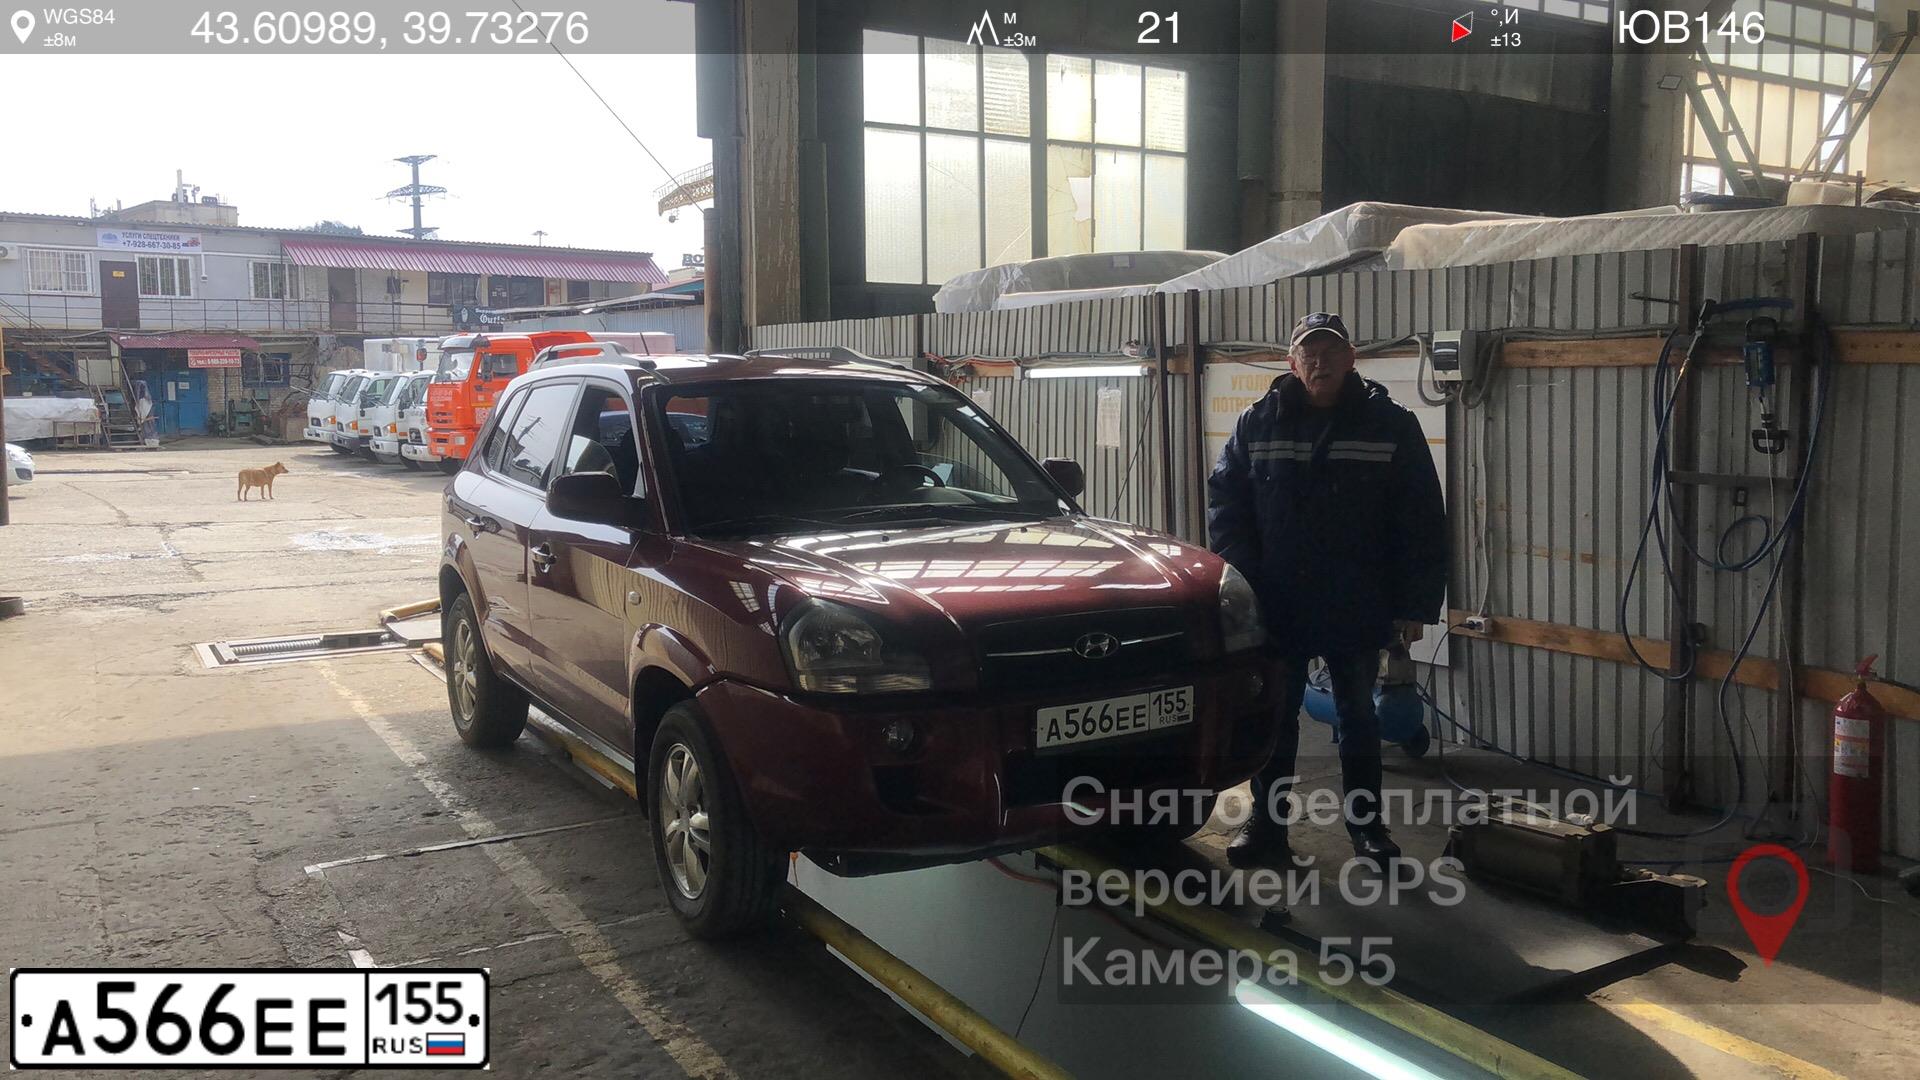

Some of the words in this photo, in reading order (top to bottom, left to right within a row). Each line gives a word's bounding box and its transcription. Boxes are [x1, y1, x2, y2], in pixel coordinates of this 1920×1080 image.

[122, 231, 142, 239] УСЛУГИ
[1231, 374, 1275, 391] УГОЛО
[1152, 690, 1187, 716] 155
[1159, 714, 1177, 725] RUS
